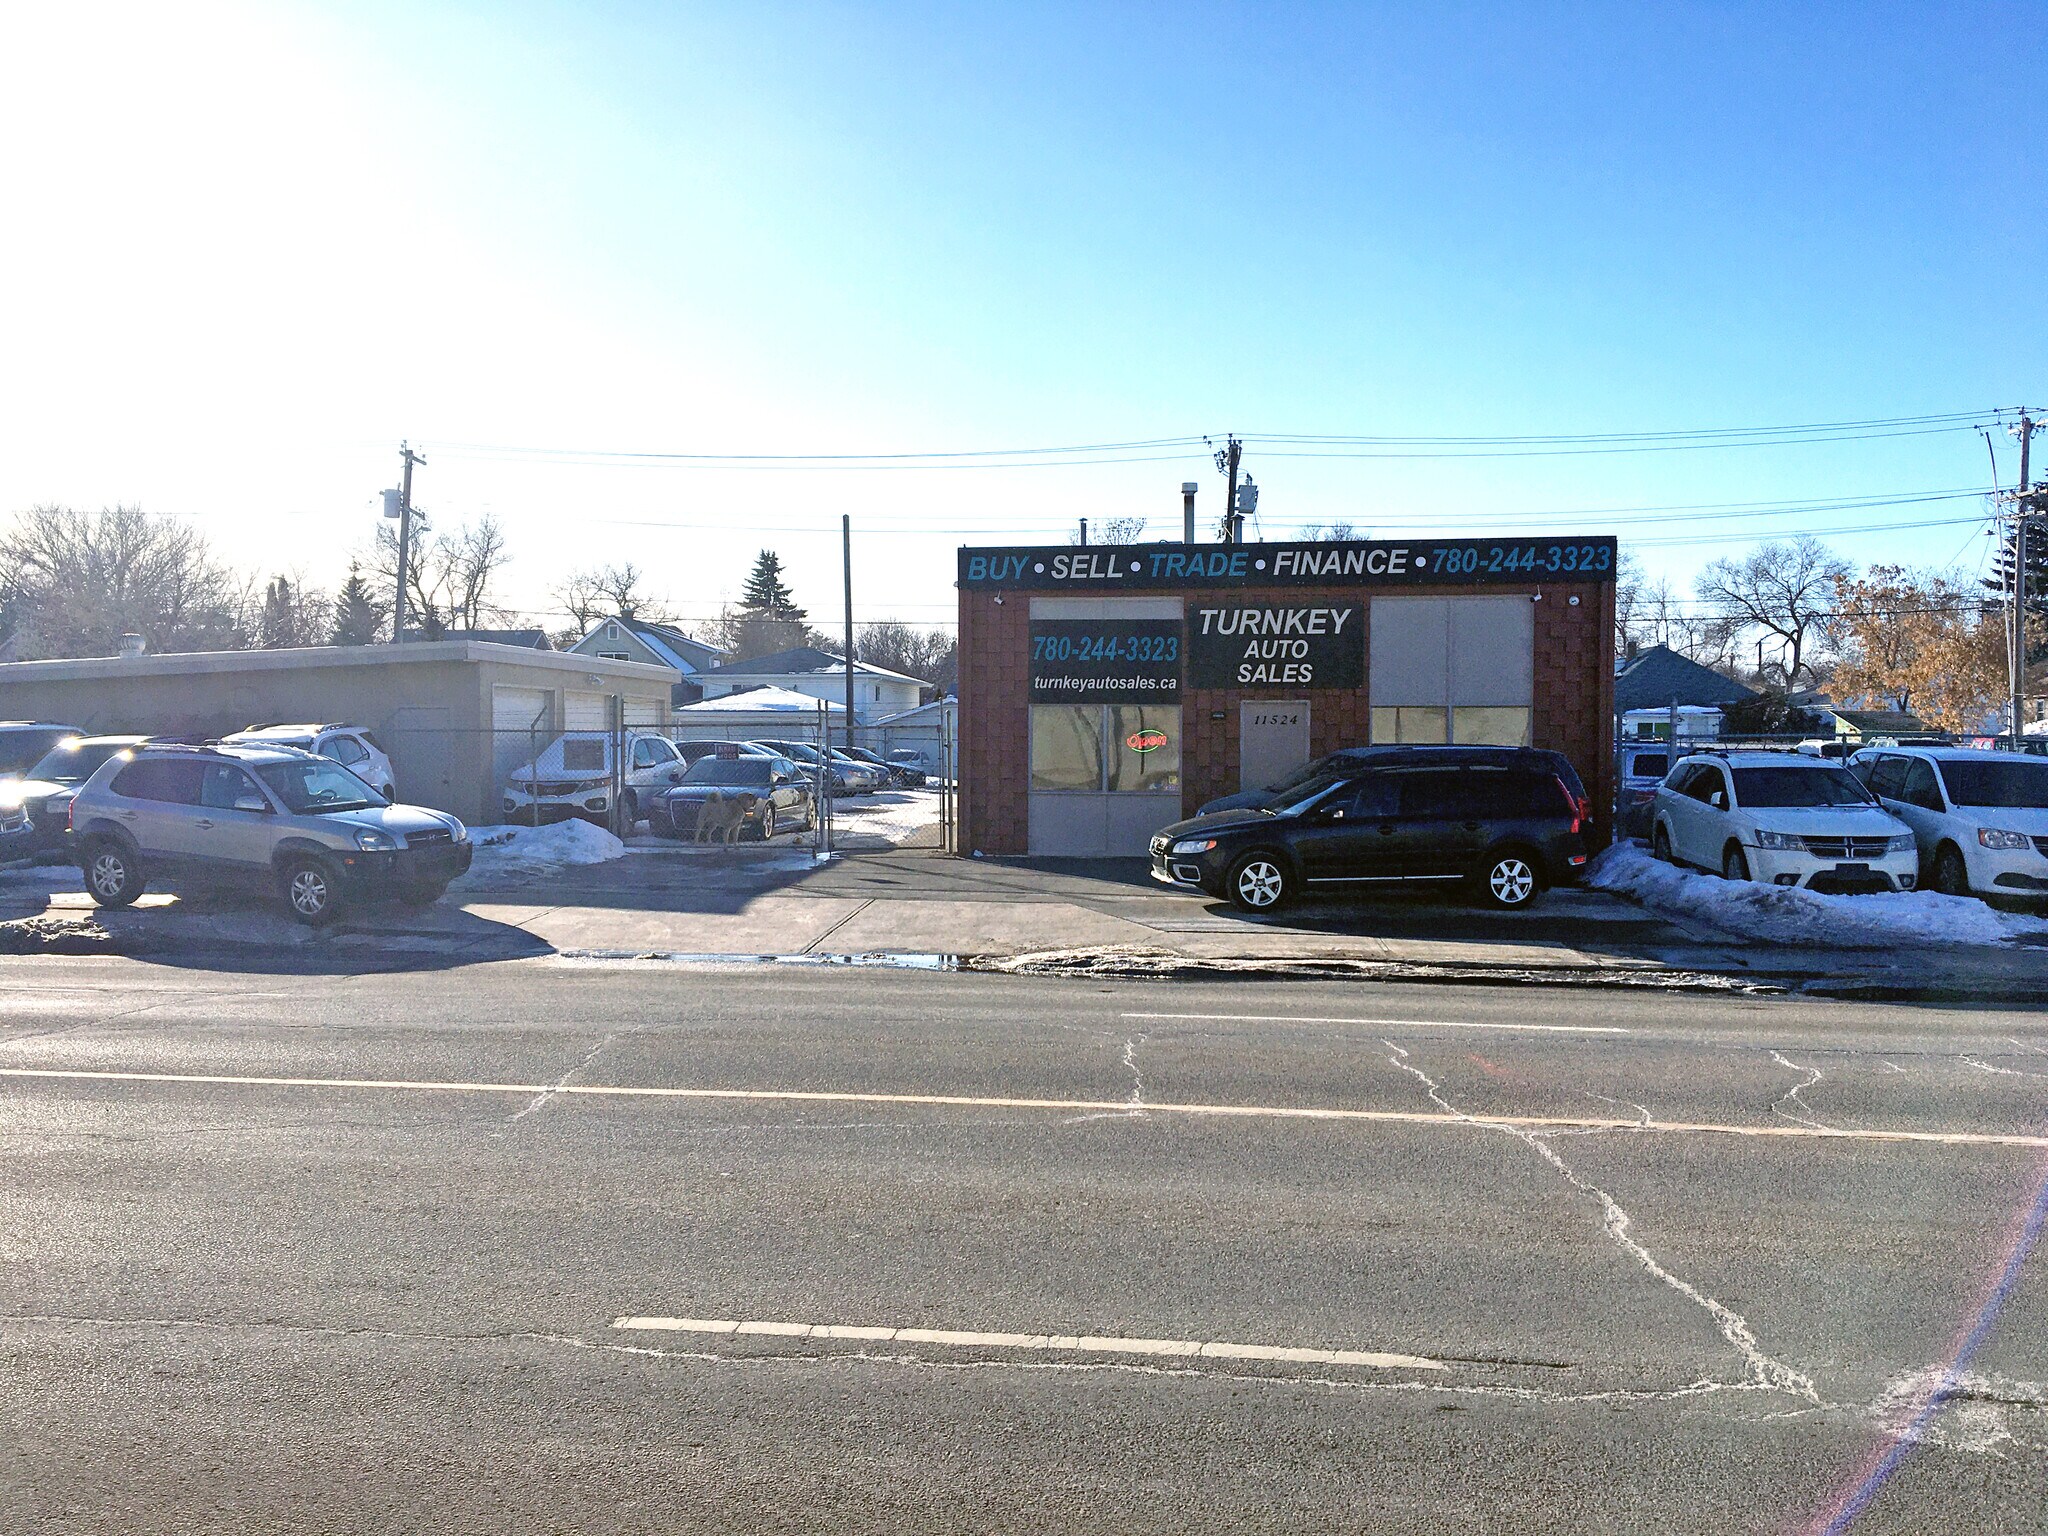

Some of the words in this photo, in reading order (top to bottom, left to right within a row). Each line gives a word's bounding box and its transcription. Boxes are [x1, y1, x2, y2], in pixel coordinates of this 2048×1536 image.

[968, 557, 1030, 580] BUY
[1051, 554, 1123, 579] SELL
[1149, 553, 1249, 577] TRADE
[1274, 550, 1409, 576] FINANCE
[1434, 546, 1611, 573] 780-244-3323
[1200, 609, 1352, 635] TURNKEY
[1033, 636, 1178, 661] 780-244-3323
[1244, 639, 1309, 659] AUTO
[1238, 663, 1313, 683] SALES
[1034, 674, 1177, 693] turnkeyautosales.ca
[1255, 715, 1298, 725] 11524
[1126, 734, 1167, 749] Open
